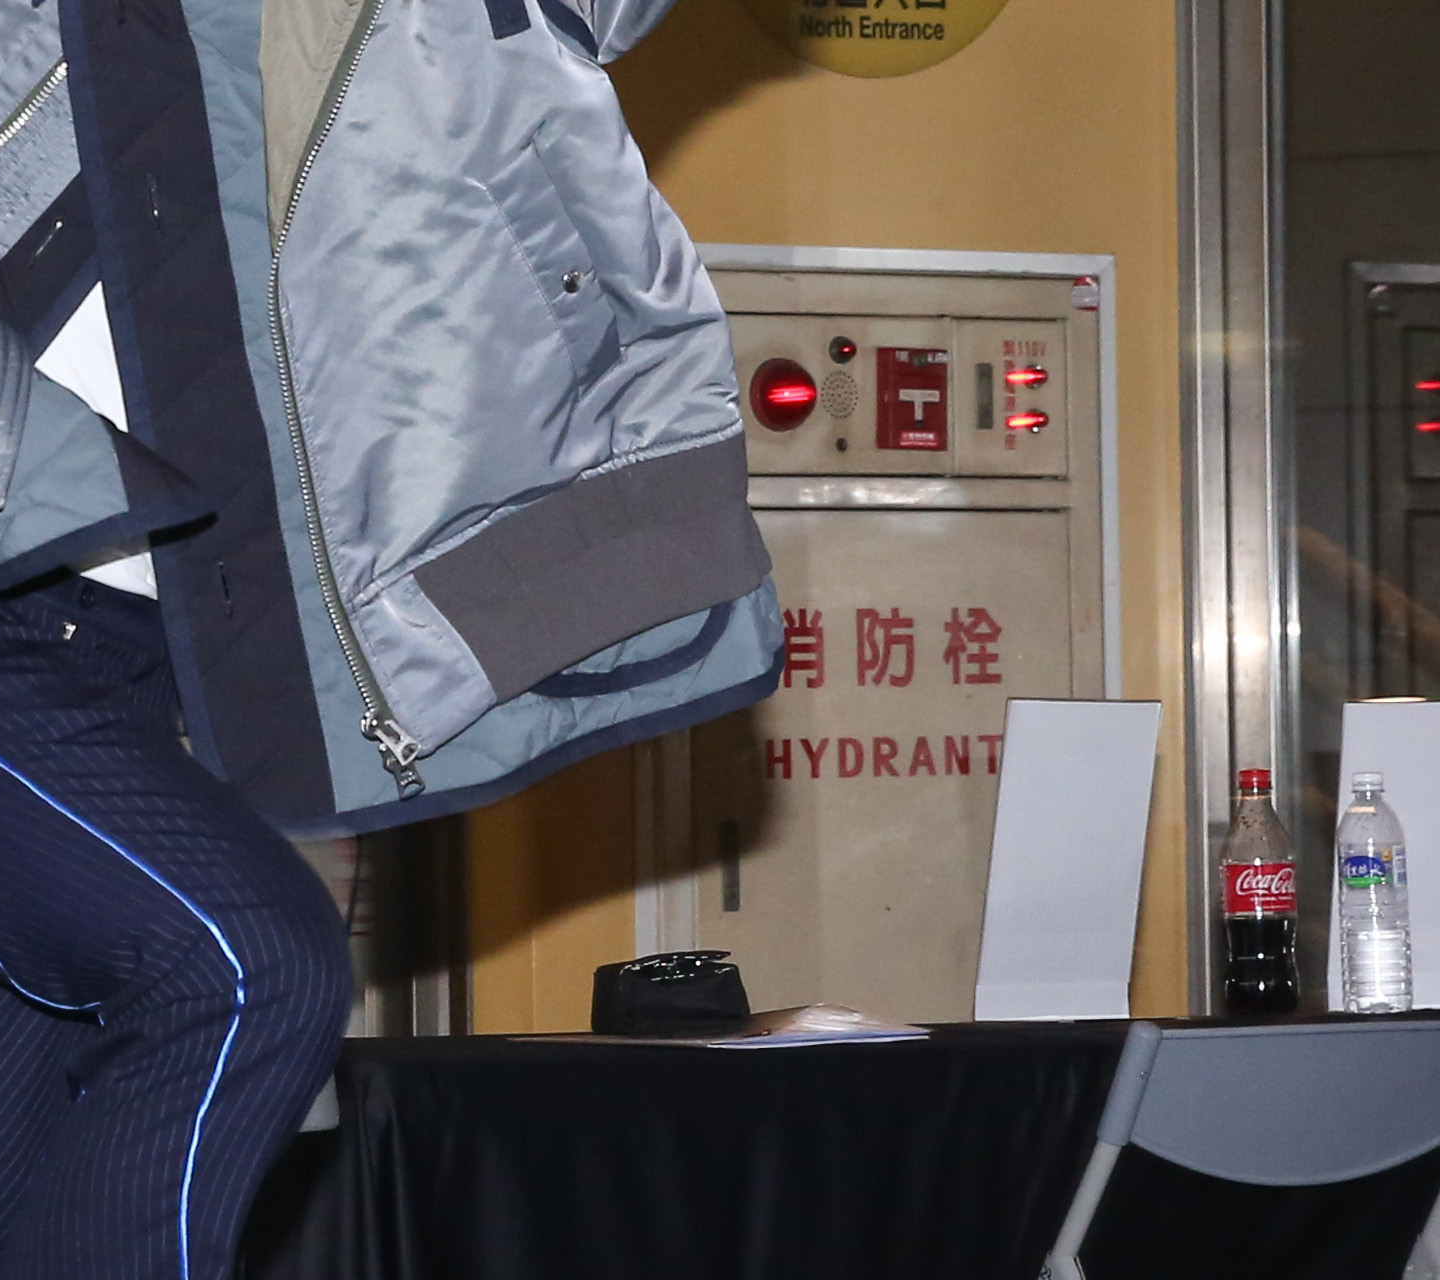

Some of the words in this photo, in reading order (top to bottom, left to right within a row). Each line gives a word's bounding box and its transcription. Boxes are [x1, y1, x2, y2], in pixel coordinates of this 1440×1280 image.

[799, 15, 853, 39] North
[859, 16, 945, 40] Entrance
[765, 734, 1004, 780] HYDRANT
